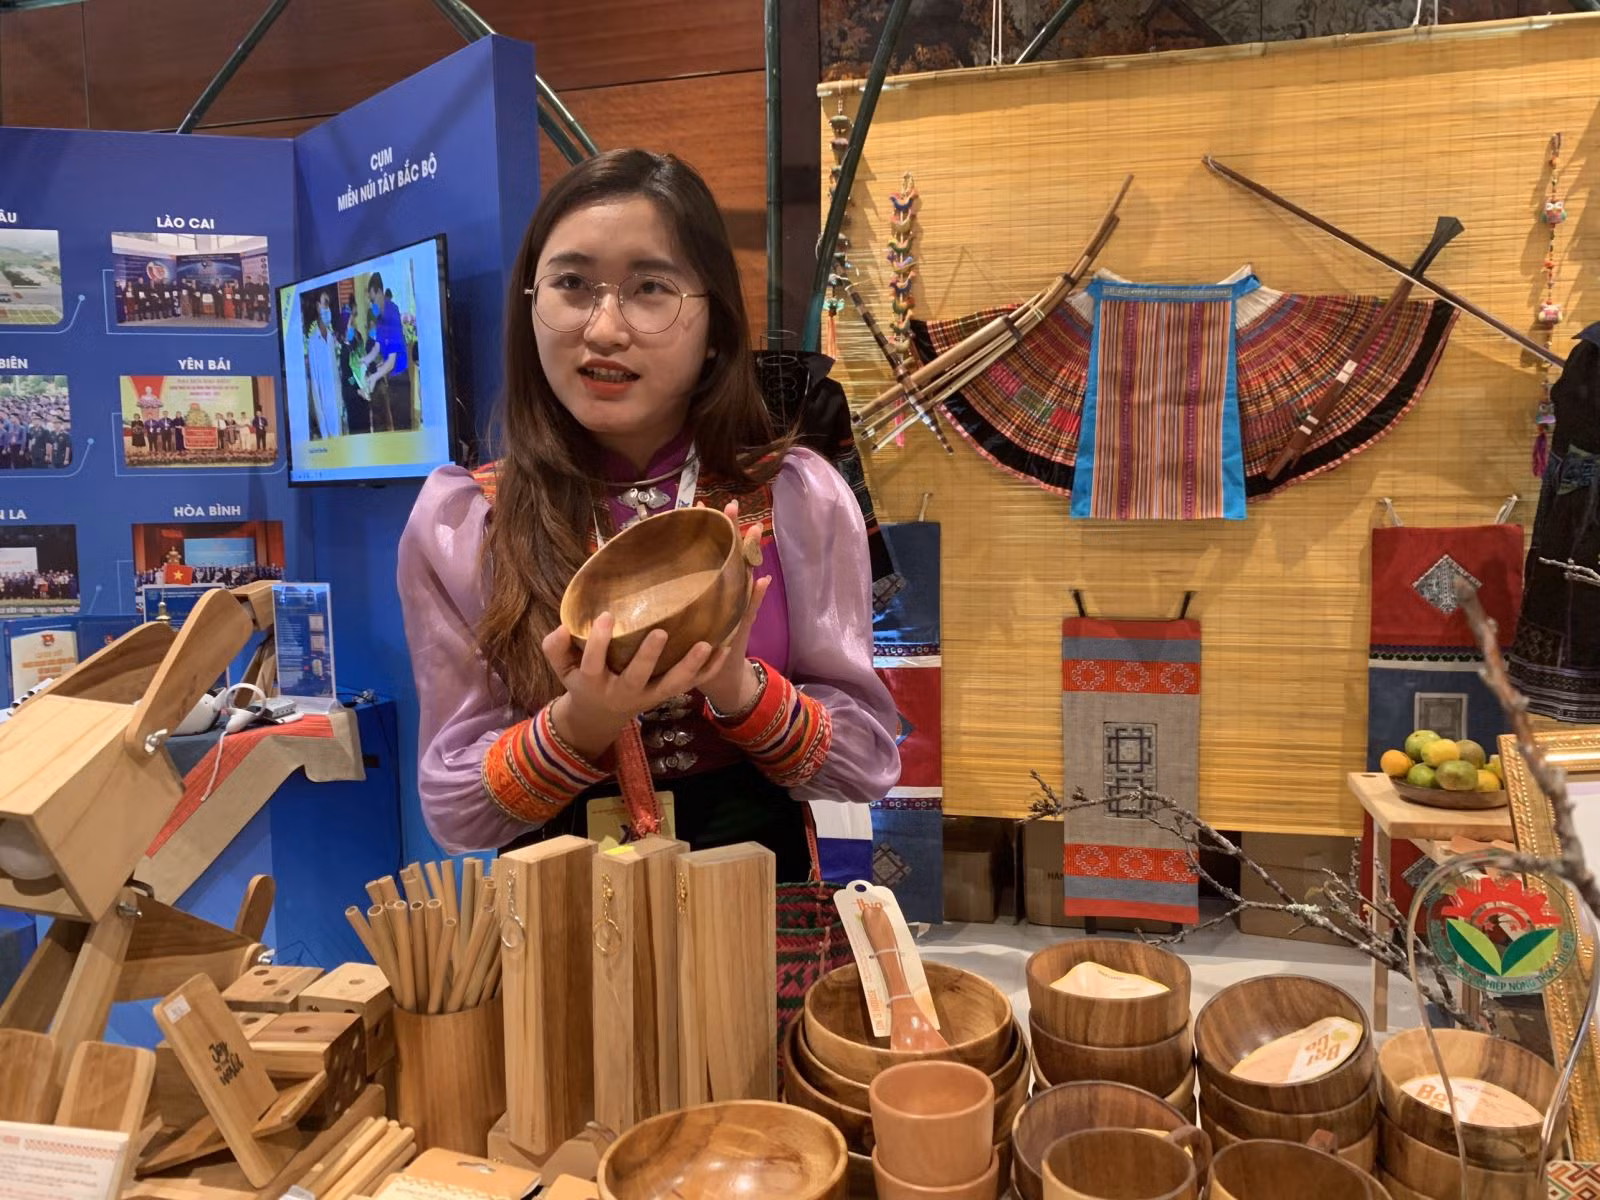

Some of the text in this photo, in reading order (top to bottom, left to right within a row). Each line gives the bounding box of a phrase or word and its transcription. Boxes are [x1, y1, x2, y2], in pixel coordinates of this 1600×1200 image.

[370, 147, 393, 172] CỤM
[337, 152, 438, 212] MIỀN NÚI TÂY BẮC BỘ
[156, 214, 215, 230] LÀO CAI
[178, 356, 231, 370] YÊN BÁI
[9, 509, 27, 520] LA
[174, 503, 241, 517] HÒA BÌNH
